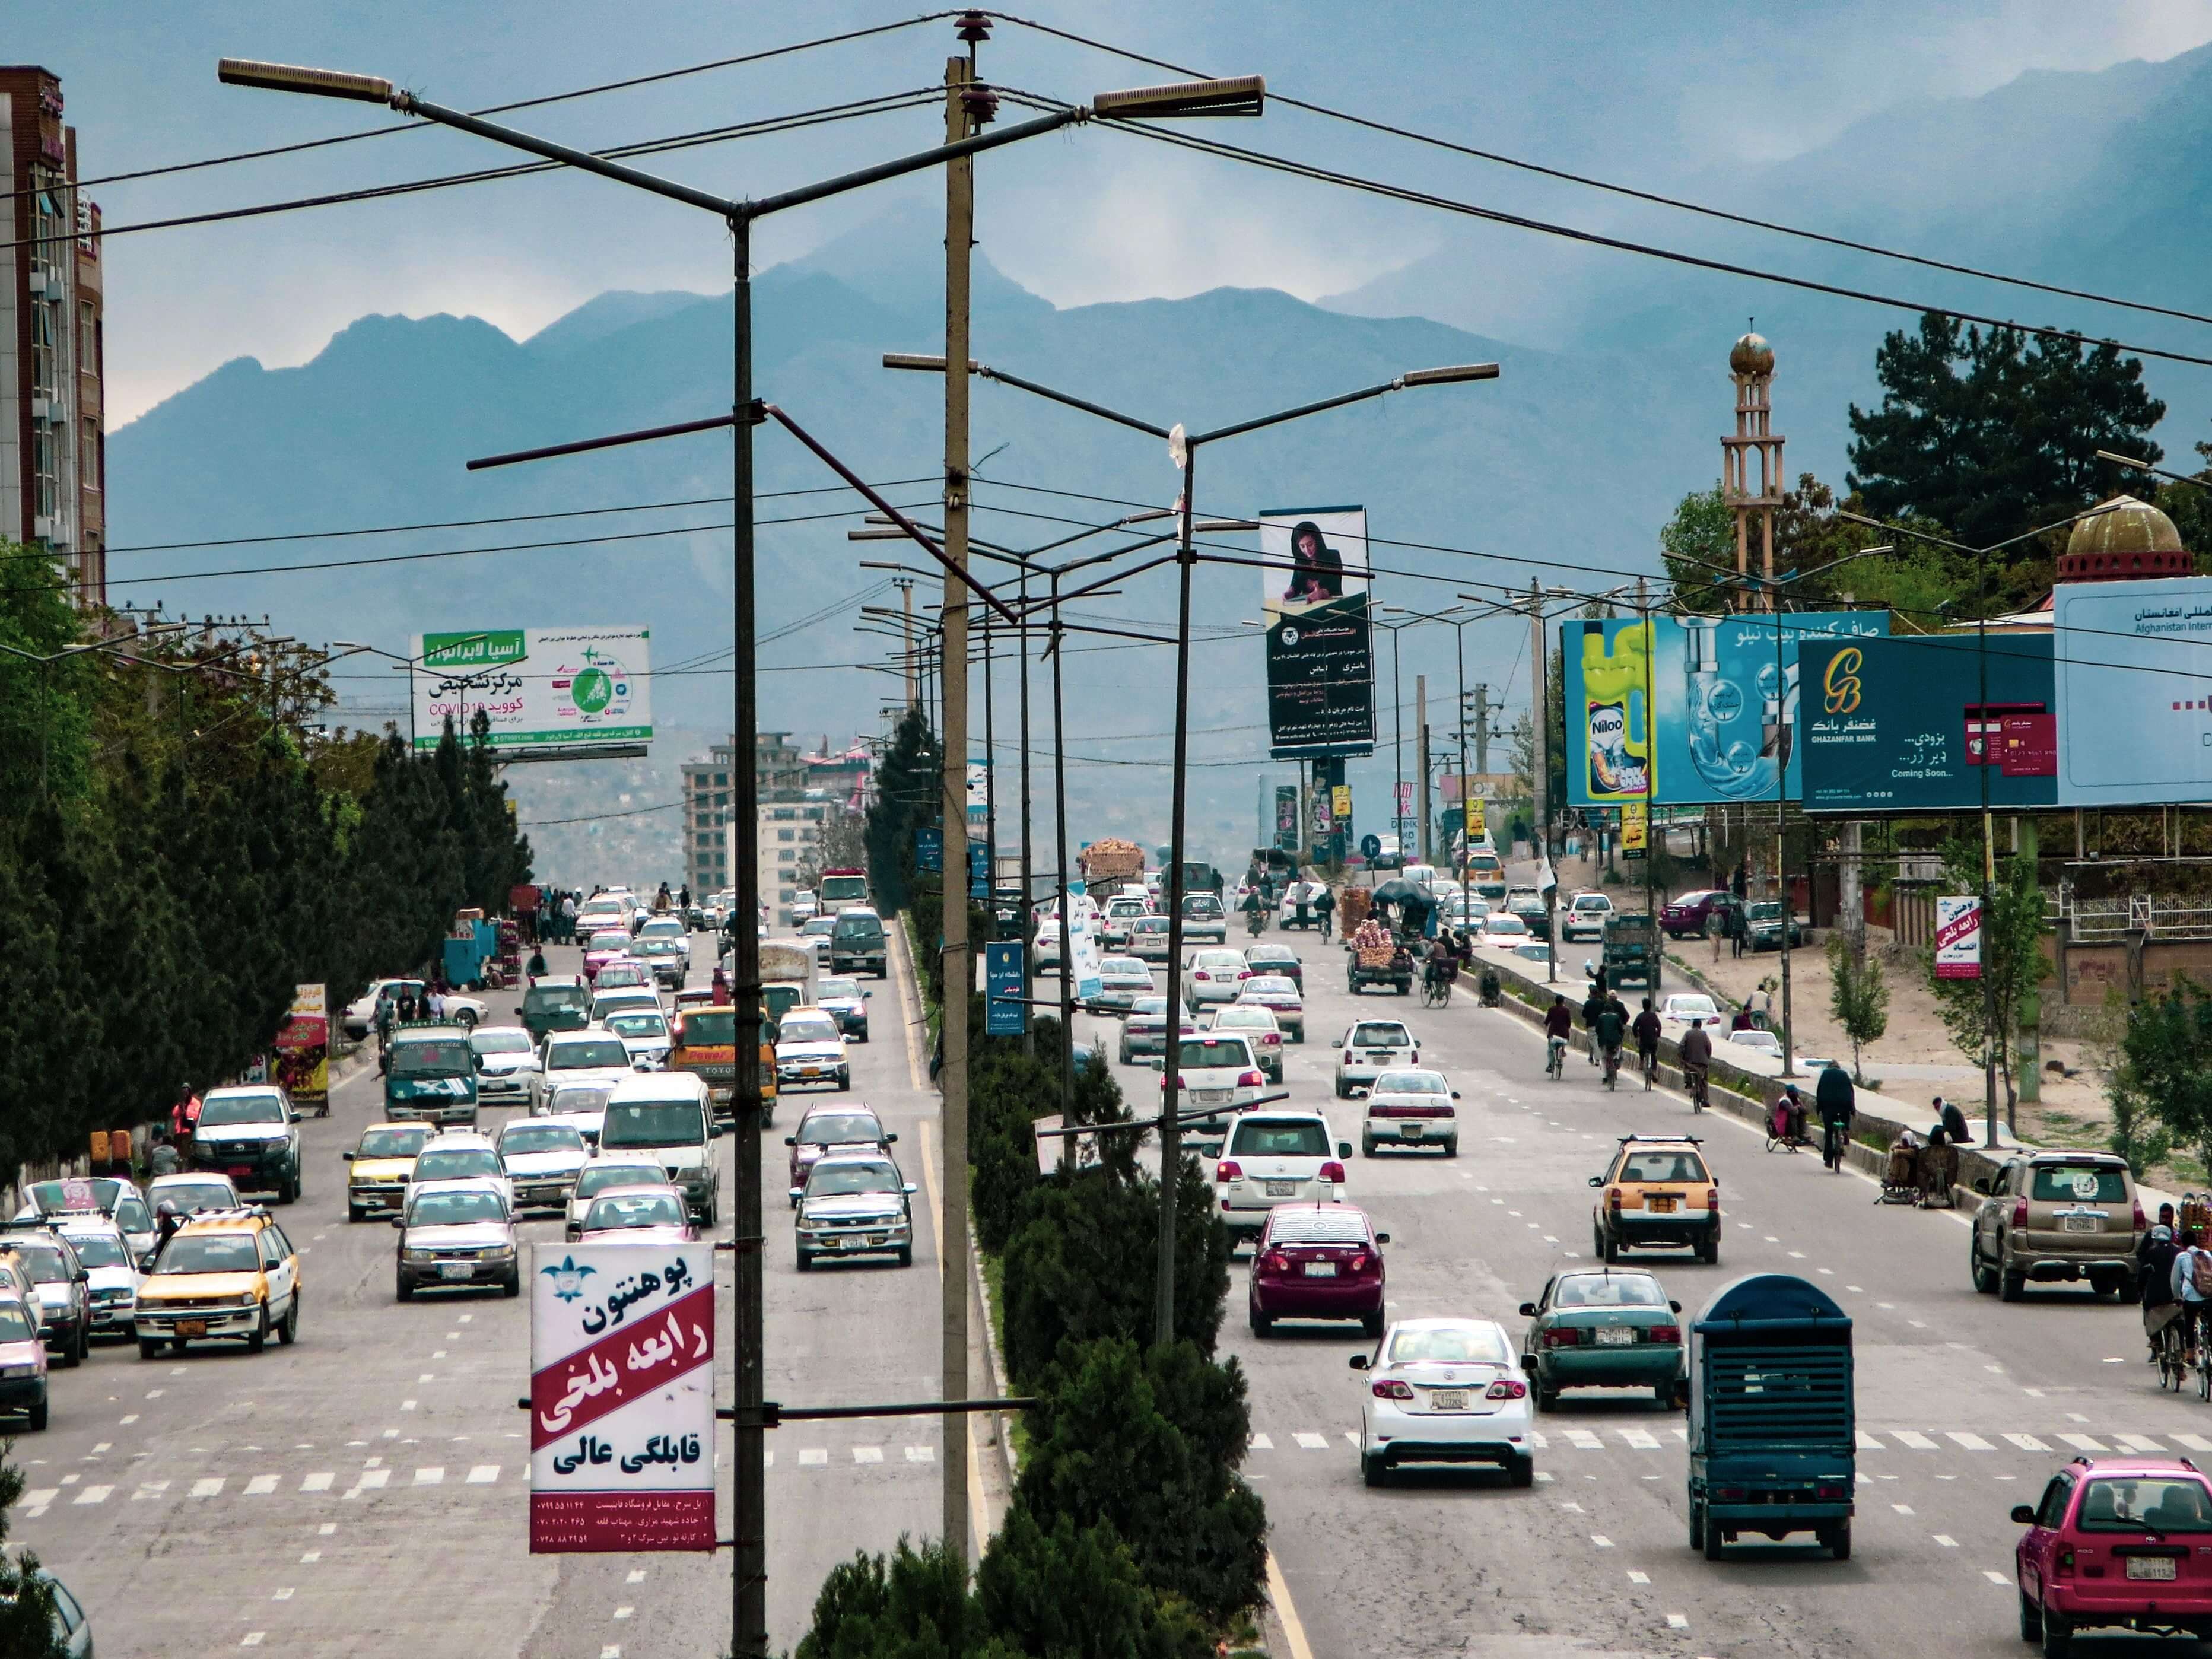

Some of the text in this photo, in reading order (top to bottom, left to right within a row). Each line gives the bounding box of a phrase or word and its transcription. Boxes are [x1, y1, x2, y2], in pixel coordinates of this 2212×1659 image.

[2135, 606, 2182, 621] افغانستان
[1735, 625, 1762, 647] نیلو
[1798, 619, 1839, 640] کننده
[1841, 620, 1879, 638] صاف
[2136, 623, 2187, 635] Afghanistan
[487, 637, 521, 660] آسیا
[490, 672, 522, 695] مرکز
[430, 703, 469, 716] COVID
[488, 697, 523, 714] کووید
[1592, 719, 1623, 735] Niloo
[1811, 716, 1876, 733] غضنفر بانک
[1892, 768, 1953, 778] Coming Soon...
[1948, 900, 1975, 921] پوهنتون
[1938, 914, 1978, 948] رابعه بلخی
[1953, 942, 1977, 951] اقتصاد
[688, 1050, 726, 1060] Power
[582, 1256, 693, 1336] پوهنتون
[540, 1311, 708, 1433] رابعه بلخی
[553, 1434, 701, 1476] قابلگی عالی
[624, 1498, 652, 1511] فروشگاه
[653, 1499, 670, 1511] مقابل
[660, 1516, 679, 1527] شهید
